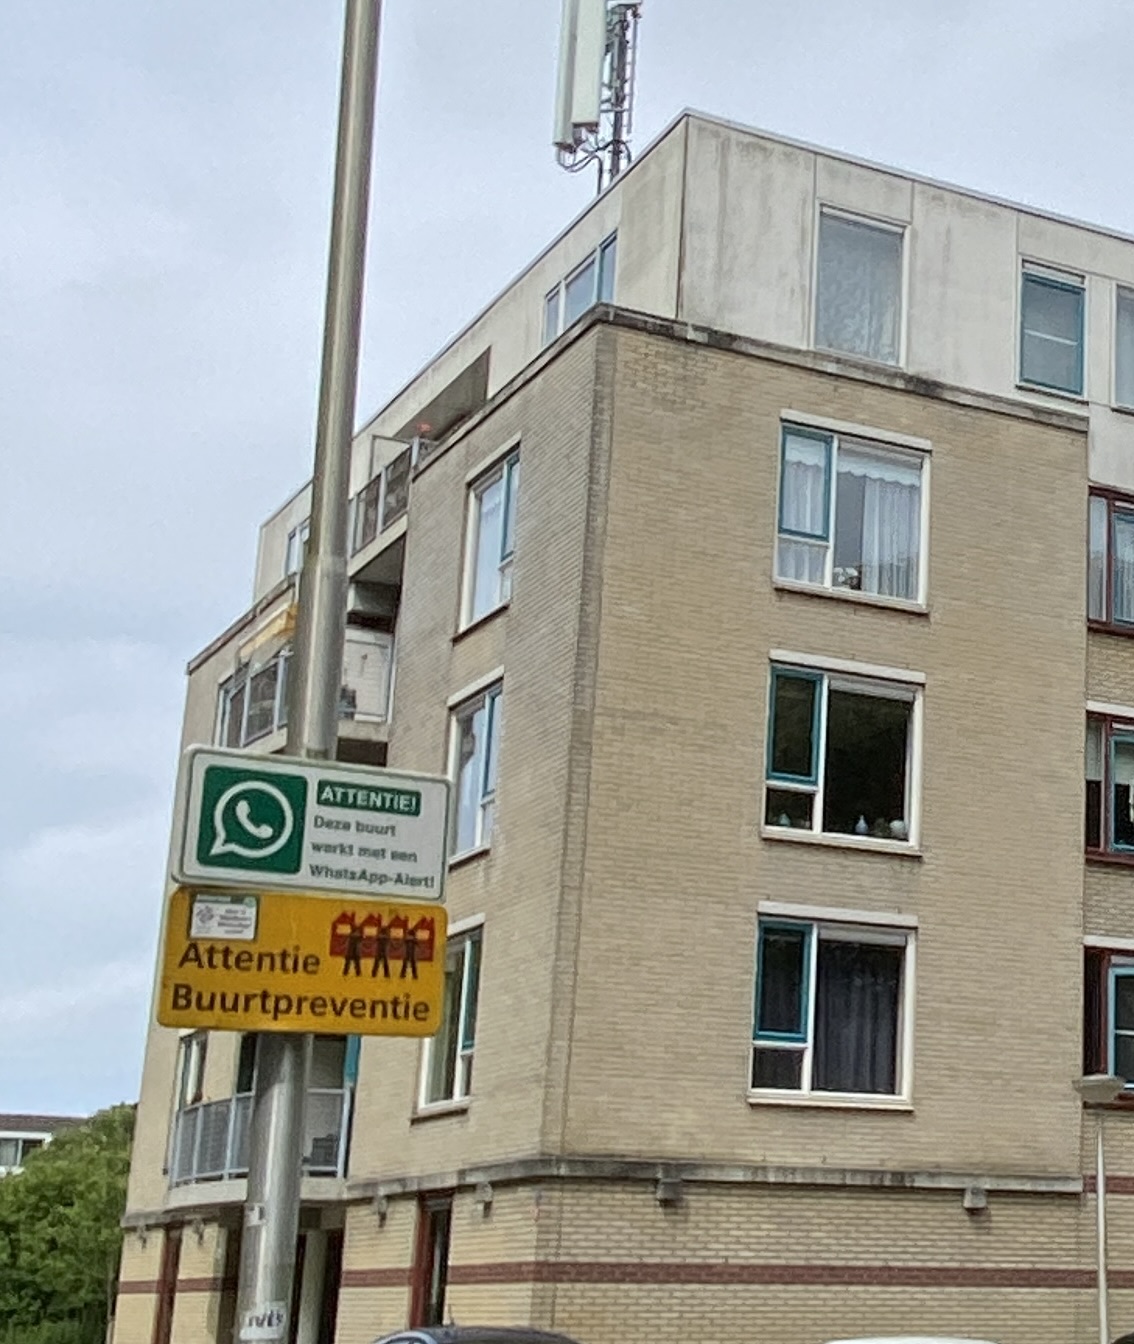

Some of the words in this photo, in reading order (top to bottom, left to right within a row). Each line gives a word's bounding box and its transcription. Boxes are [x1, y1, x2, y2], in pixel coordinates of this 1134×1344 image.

[321, 785, 417, 812] ATTENTIE!
[313, 815, 351, 831] Deze
[355, 820, 396, 837] buurt
[310, 841, 354, 857] werkt
[358, 846, 387, 860] met
[390, 850, 418, 863] een
[309, 863, 435, 889] WhatsApp-Alert!
[178, 942, 321, 975] Attentie
[171, 983, 431, 1021] Buurtpreventie
